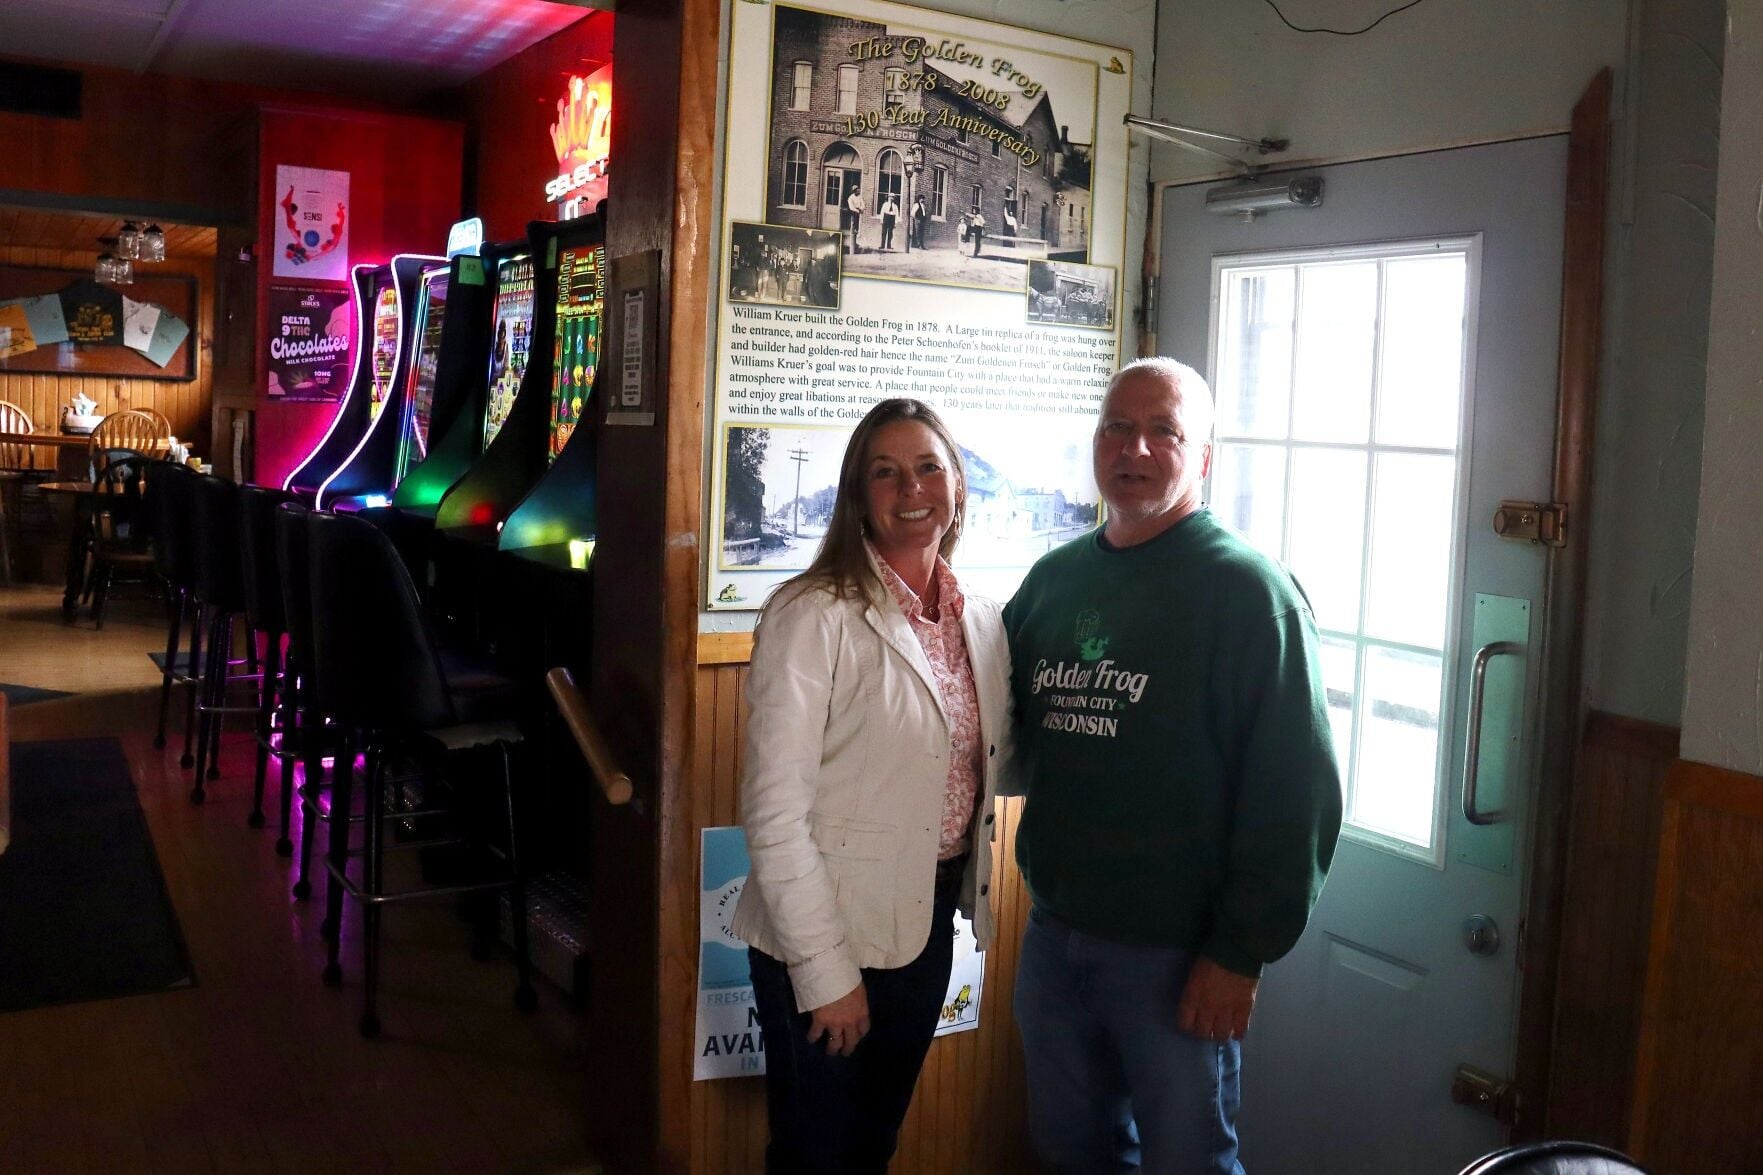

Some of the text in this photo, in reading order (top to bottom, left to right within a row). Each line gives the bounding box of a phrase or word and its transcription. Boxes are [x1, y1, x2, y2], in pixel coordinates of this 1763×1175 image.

[848, 36, 1042, 97] The Golden Frog
[886, 72, 937, 91] 1878
[958, 79, 1010, 110] 2008
[846, 103, 1040, 166] 130 Year Anniversary
[545, 152, 609, 203] SELECT
[281, 315, 311, 325] DELTA
[282, 325, 311, 336] 9 THC
[733, 307, 771, 320] William
[775, 310, 802, 322] Kruer
[805, 312, 826, 324] built
[830, 315, 843, 325] the
[846, 315, 879, 328] Golden
[882, 319, 902, 333] Frog
[905, 320, 914, 331] in
[917, 321, 940, 333] 1878.
[946, 324, 953, 334] A
[956, 325, 980, 337] Large
[982, 327, 993, 337] tin
[996, 329, 1023, 341] replica
[1025, 330, 1035, 340] of
[1042, 332, 1058, 345] frog
[1061, 335, 1076, 344] was
[1077, 335, 1097, 347] hung
[1099, 339, 1116, 347] over
[270, 333, 349, 360] Chocolates
[732, 323, 747, 334] the
[749, 326, 793, 338] entrance,
[796, 328, 813, 339] and
[816, 331, 861, 345] according
[863, 334, 873, 343] to
[875, 333, 889, 344] the
[891, 334, 914, 346] Peter
[981, 341, 1011, 353] booklet
[1013, 343, 1023, 353] of
[1048, 347, 1060, 357] the
[1062, 348, 1088, 359] saloon
[1089, 350, 1115, 362] keeper
[301, 354, 335, 363] CHOCOLATE
[731, 340, 749, 350] and
[752, 340, 786, 352] builder
[788, 343, 805, 354] had
[808, 345, 858, 358] golden-red
[861, 348, 878, 358] hair
[881, 349, 906, 360] hence
[909, 351, 922, 362] the
[925, 354, 948, 363] name
[1053, 363, 1060, 371] or
[1063, 361, 1090, 373] Golden
[1093, 364, 1113, 377] Frog.
[731, 355, 774, 368] Williams
[777, 358, 813, 370] Kruer's
[816, 361, 836, 373] goal
[839, 364, 856, 373] was
[859, 364, 867, 373] to
[870, 364, 904, 376] provide
[907, 366, 945, 378] Fountain
[947, 368, 965, 381] City
[968, 371, 987, 381] with
[995, 371, 1017, 384] place
[1037, 374, 1050, 384] had
[1060, 378, 1082, 387] warm
[730, 373, 785, 386] atmosphere
[788, 375, 808, 385] with
[811, 377, 835, 389] great
[838, 378, 872, 389] service.
[876, 380, 882, 390] A
[885, 380, 908, 392] place
[911, 381, 927, 391] that
[930, 384, 957, 396] people
[961, 386, 983, 395] could
[729, 388, 746, 398] and
[749, 389, 776, 402] enjoy
[779, 392, 802, 402] great
[806, 391, 846, 403] libations
[848, 395, 856, 403] at
[944, 398, 958, 408] 130
[961, 400, 982, 411] years
[729, 403, 759, 415] within
[762, 405, 777, 415] the
[780, 406, 805, 416] walls
[807, 407, 818, 417] of
[820, 407, 834, 418] the
[1032, 658, 1149, 703] Golden Frog
[1090, 697, 1117, 711] CITY
[719, 885, 739, 907] REAL
